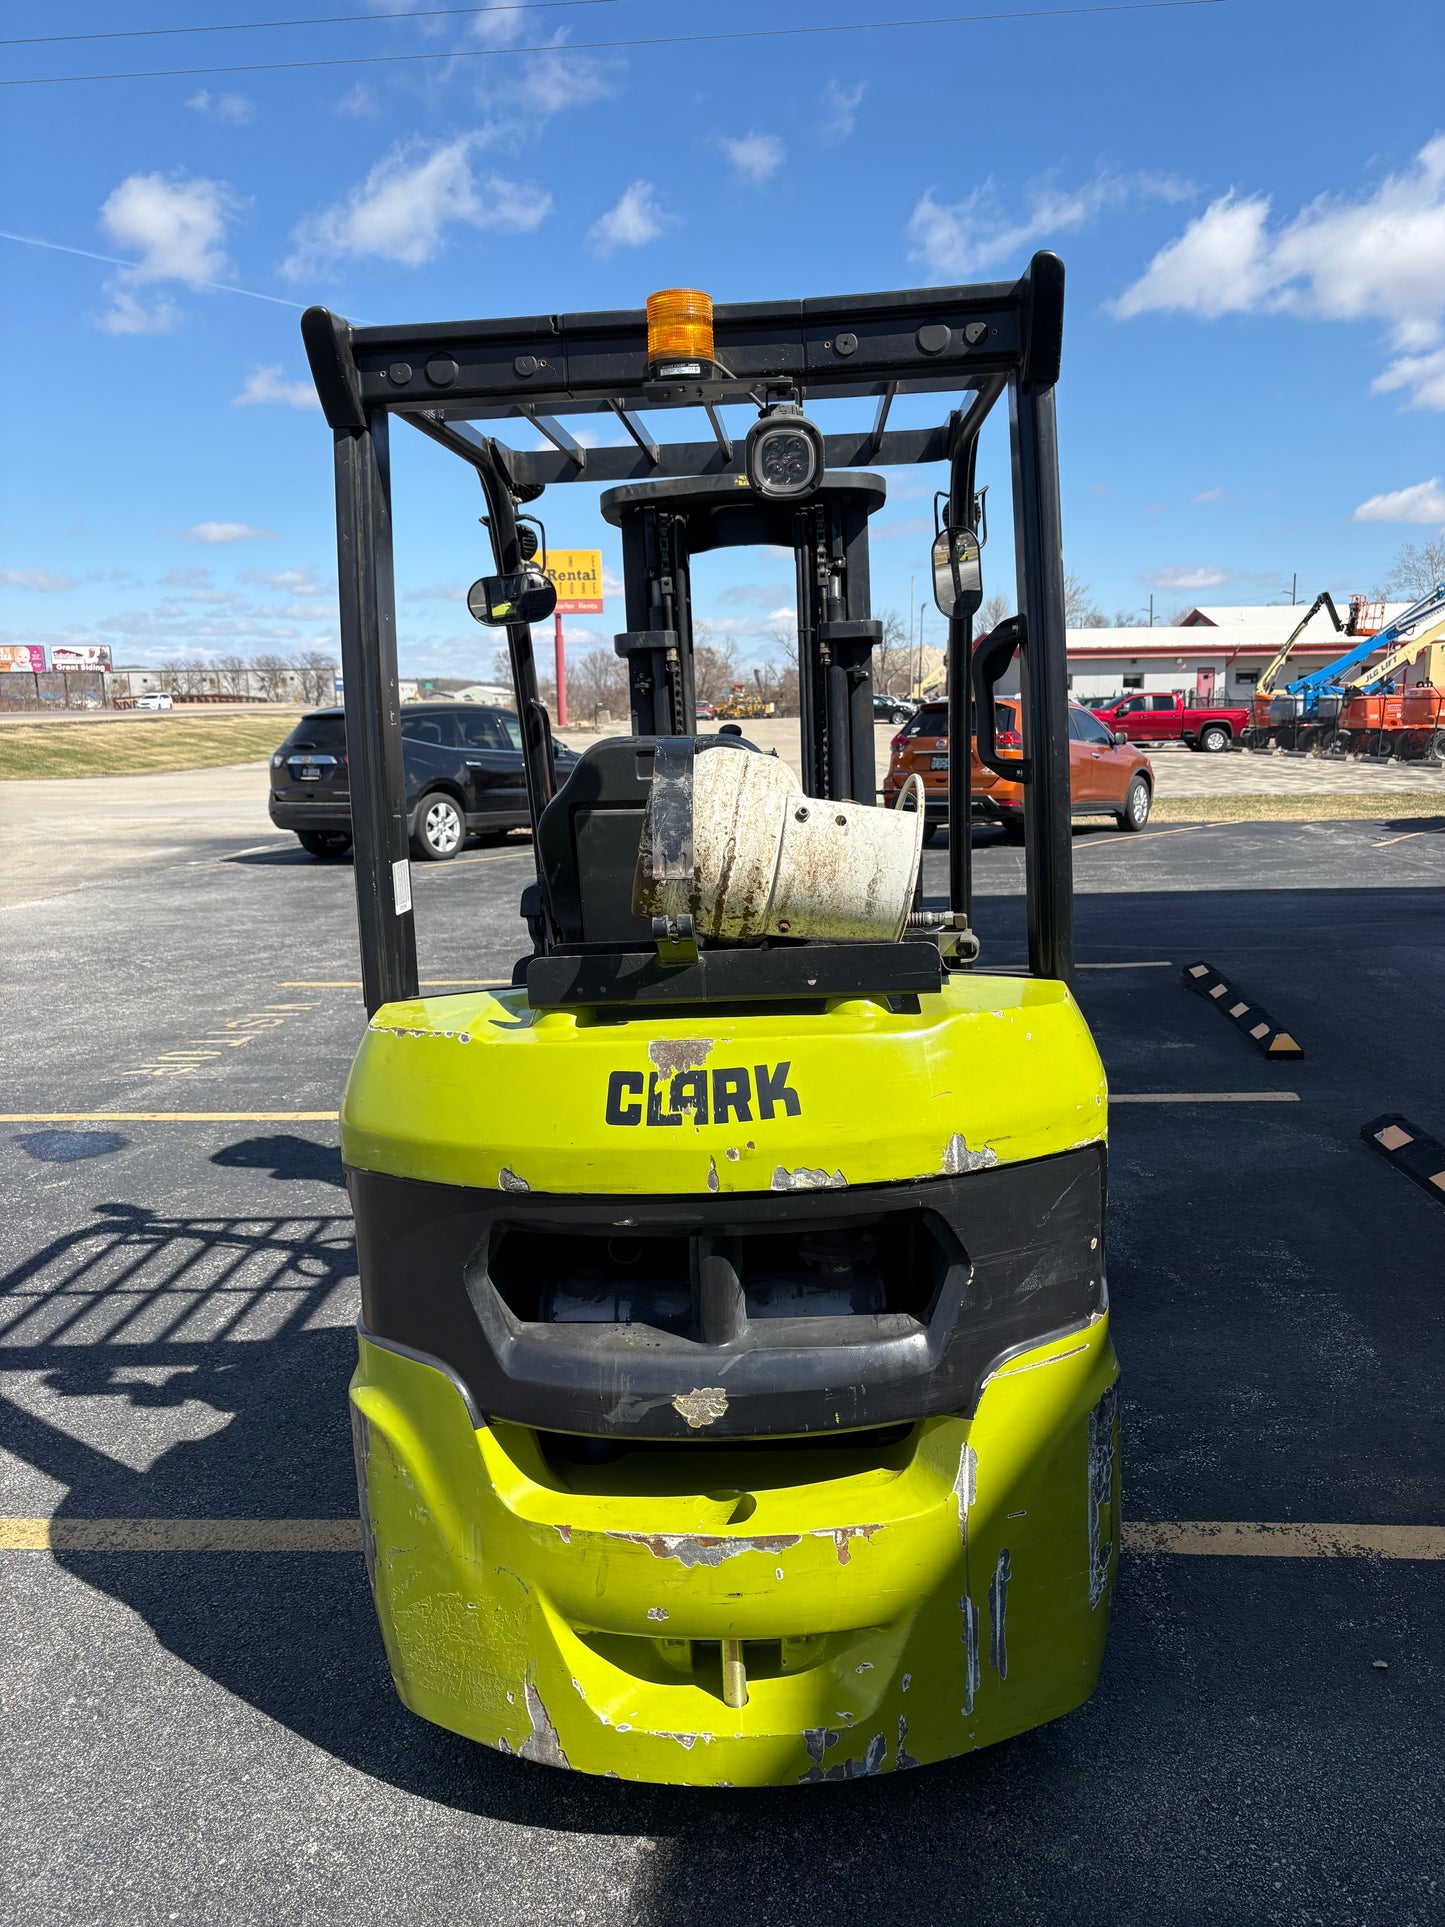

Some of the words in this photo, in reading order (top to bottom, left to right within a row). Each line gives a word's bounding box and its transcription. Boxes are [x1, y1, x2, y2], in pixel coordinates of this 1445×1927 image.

[546, 569, 596, 581] Rental
[559, 582, 596, 594] TORE
[80, 663, 106, 672] Siding
[1366, 669, 1379, 682] JLG
[1381, 656, 1397, 671] LIFT
[606, 1061, 802, 1126] CLARK
